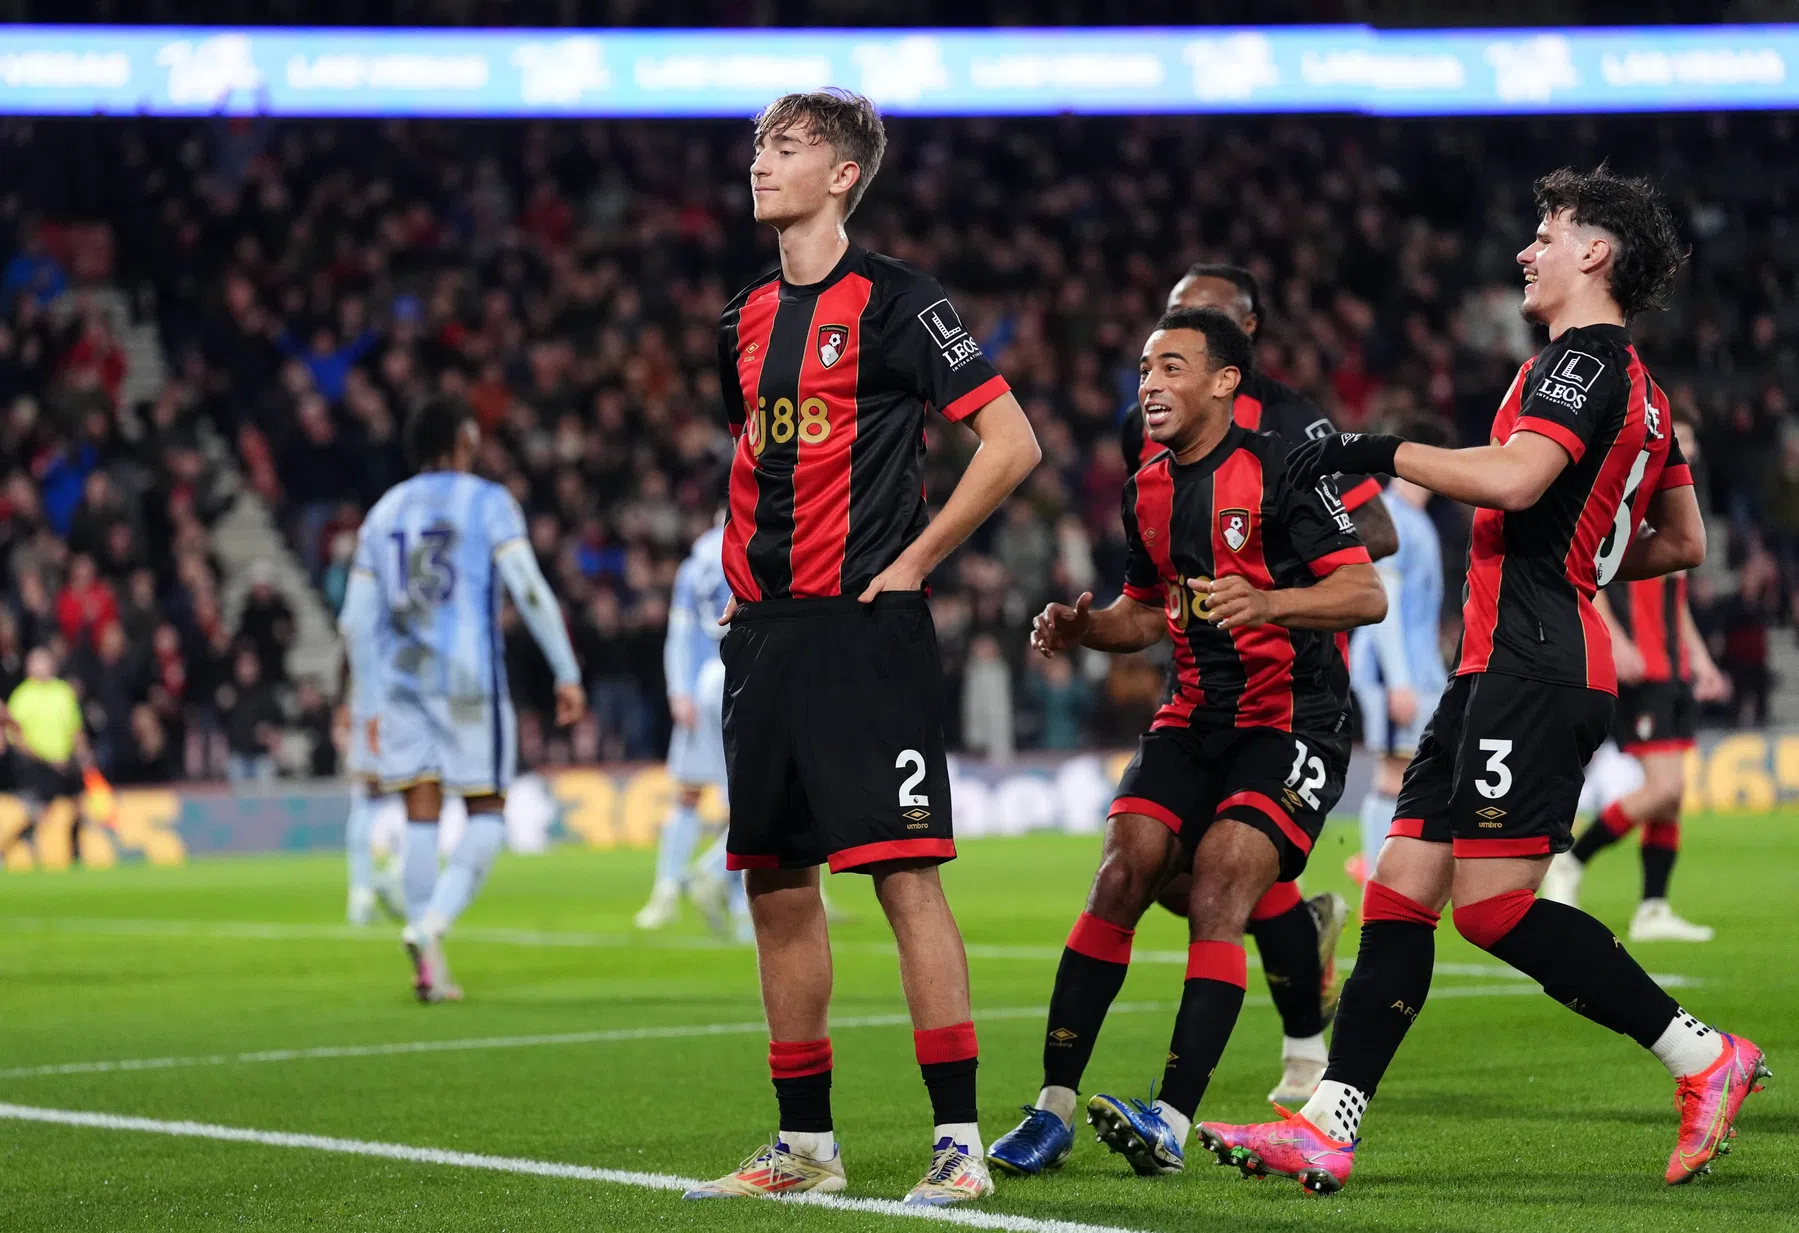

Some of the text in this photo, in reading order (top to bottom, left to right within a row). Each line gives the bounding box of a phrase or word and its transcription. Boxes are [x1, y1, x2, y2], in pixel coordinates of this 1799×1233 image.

[942, 337, 979, 367] LEOS
[1536, 392, 1578, 416] INTERNATIONAL
[1539, 378, 1587, 409] LEOS
[388, 528, 457, 608] 13
[895, 749, 929, 806] 2
[1284, 739, 1326, 811] 12
[1475, 738, 1512, 799] 3
